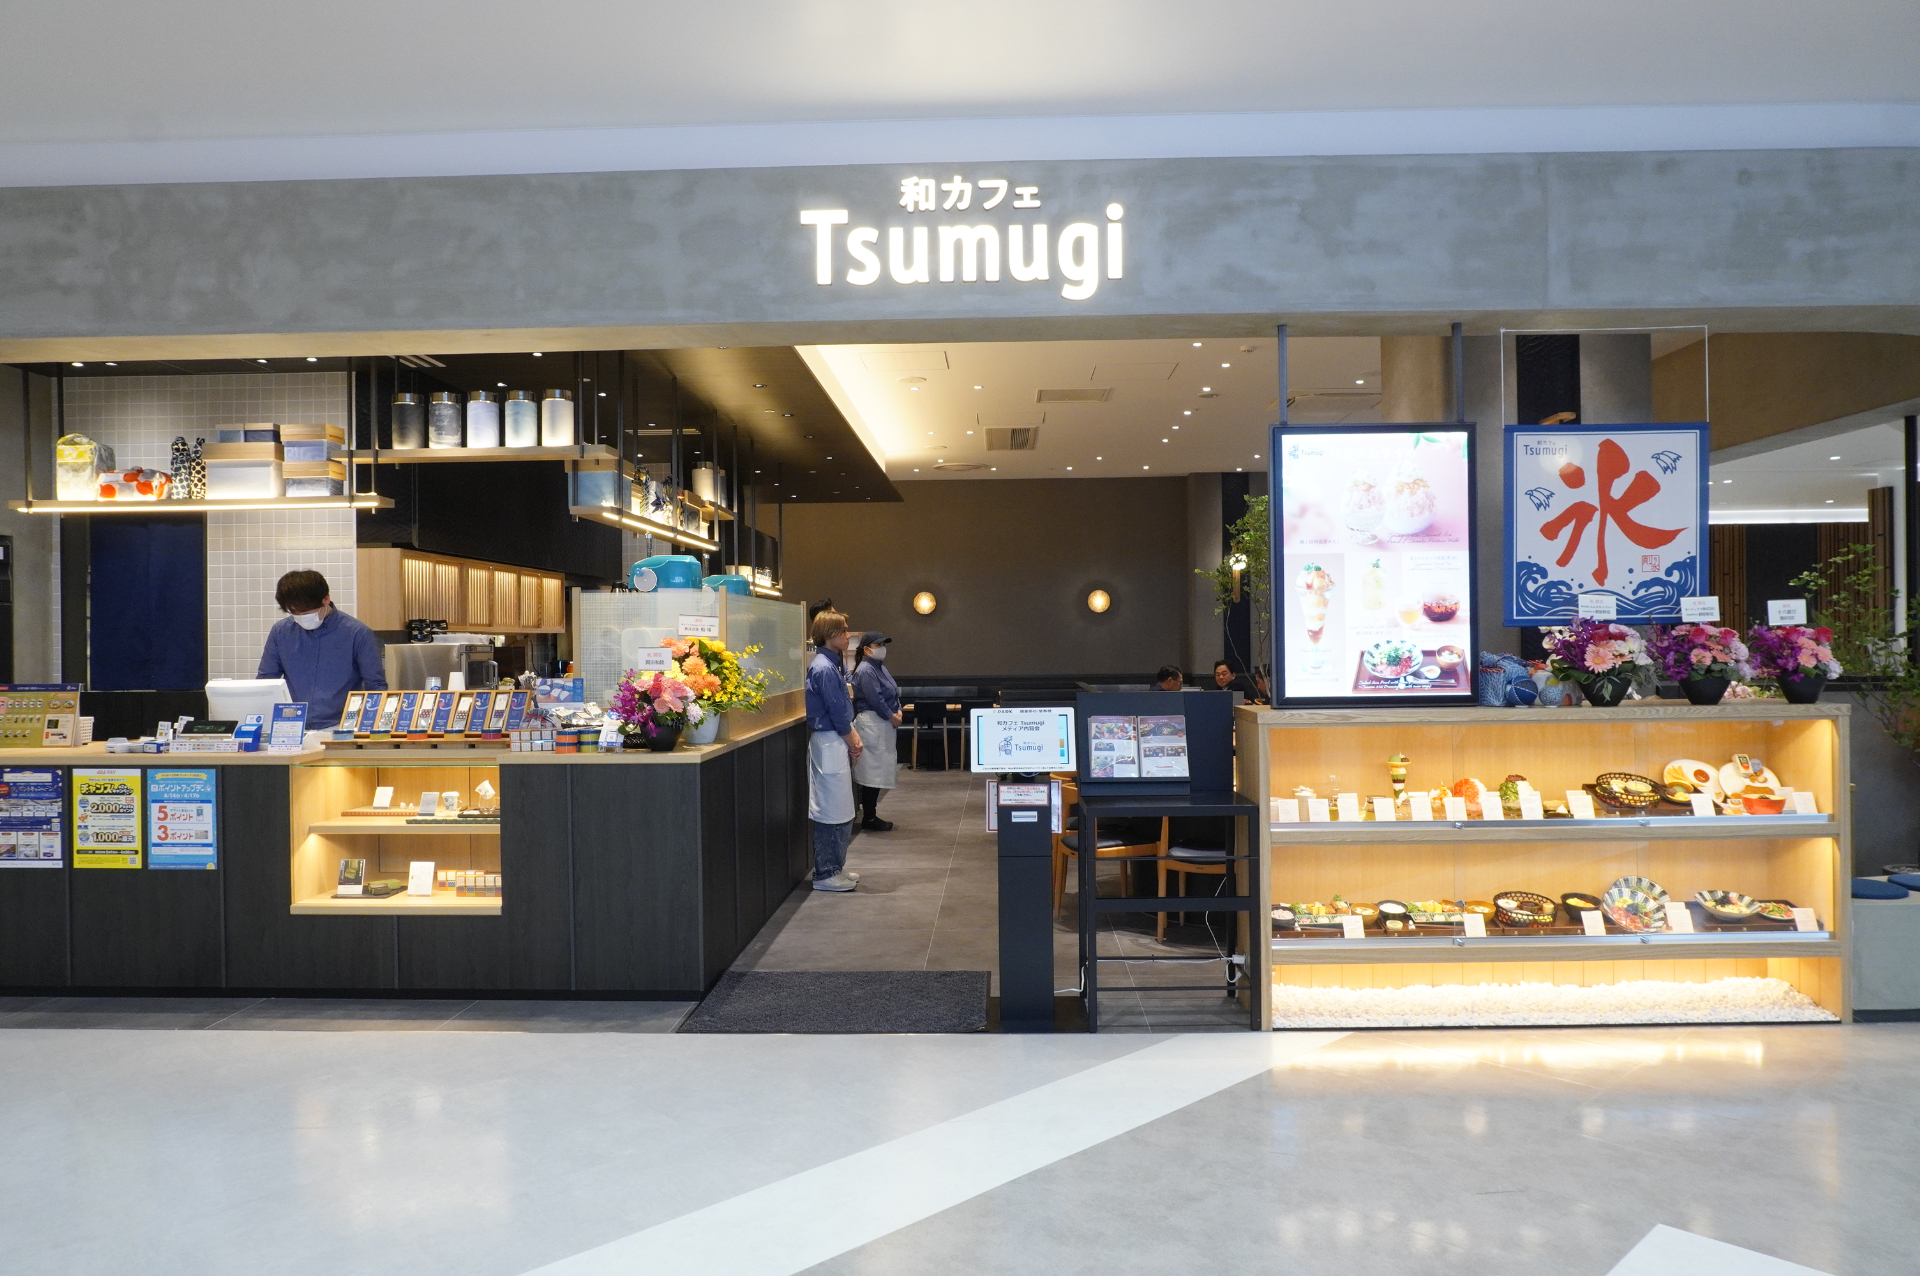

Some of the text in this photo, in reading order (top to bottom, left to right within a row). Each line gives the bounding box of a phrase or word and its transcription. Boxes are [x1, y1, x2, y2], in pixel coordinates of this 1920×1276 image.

[899, 175, 1041, 213] 和カフェ
[799, 203, 1124, 301] Tsumugi
[1301, 448, 1325, 457] Tsumugi
[1523, 444, 1568, 458] Tsumugi
[1539, 437, 1690, 587] 氷
[1014, 744, 1044, 752] Tsumugi
[157, 805, 169, 821] 5
[169, 813, 193, 821] ポイント
[156, 825, 169, 841] 3
[169, 832, 193, 840] ポイント
